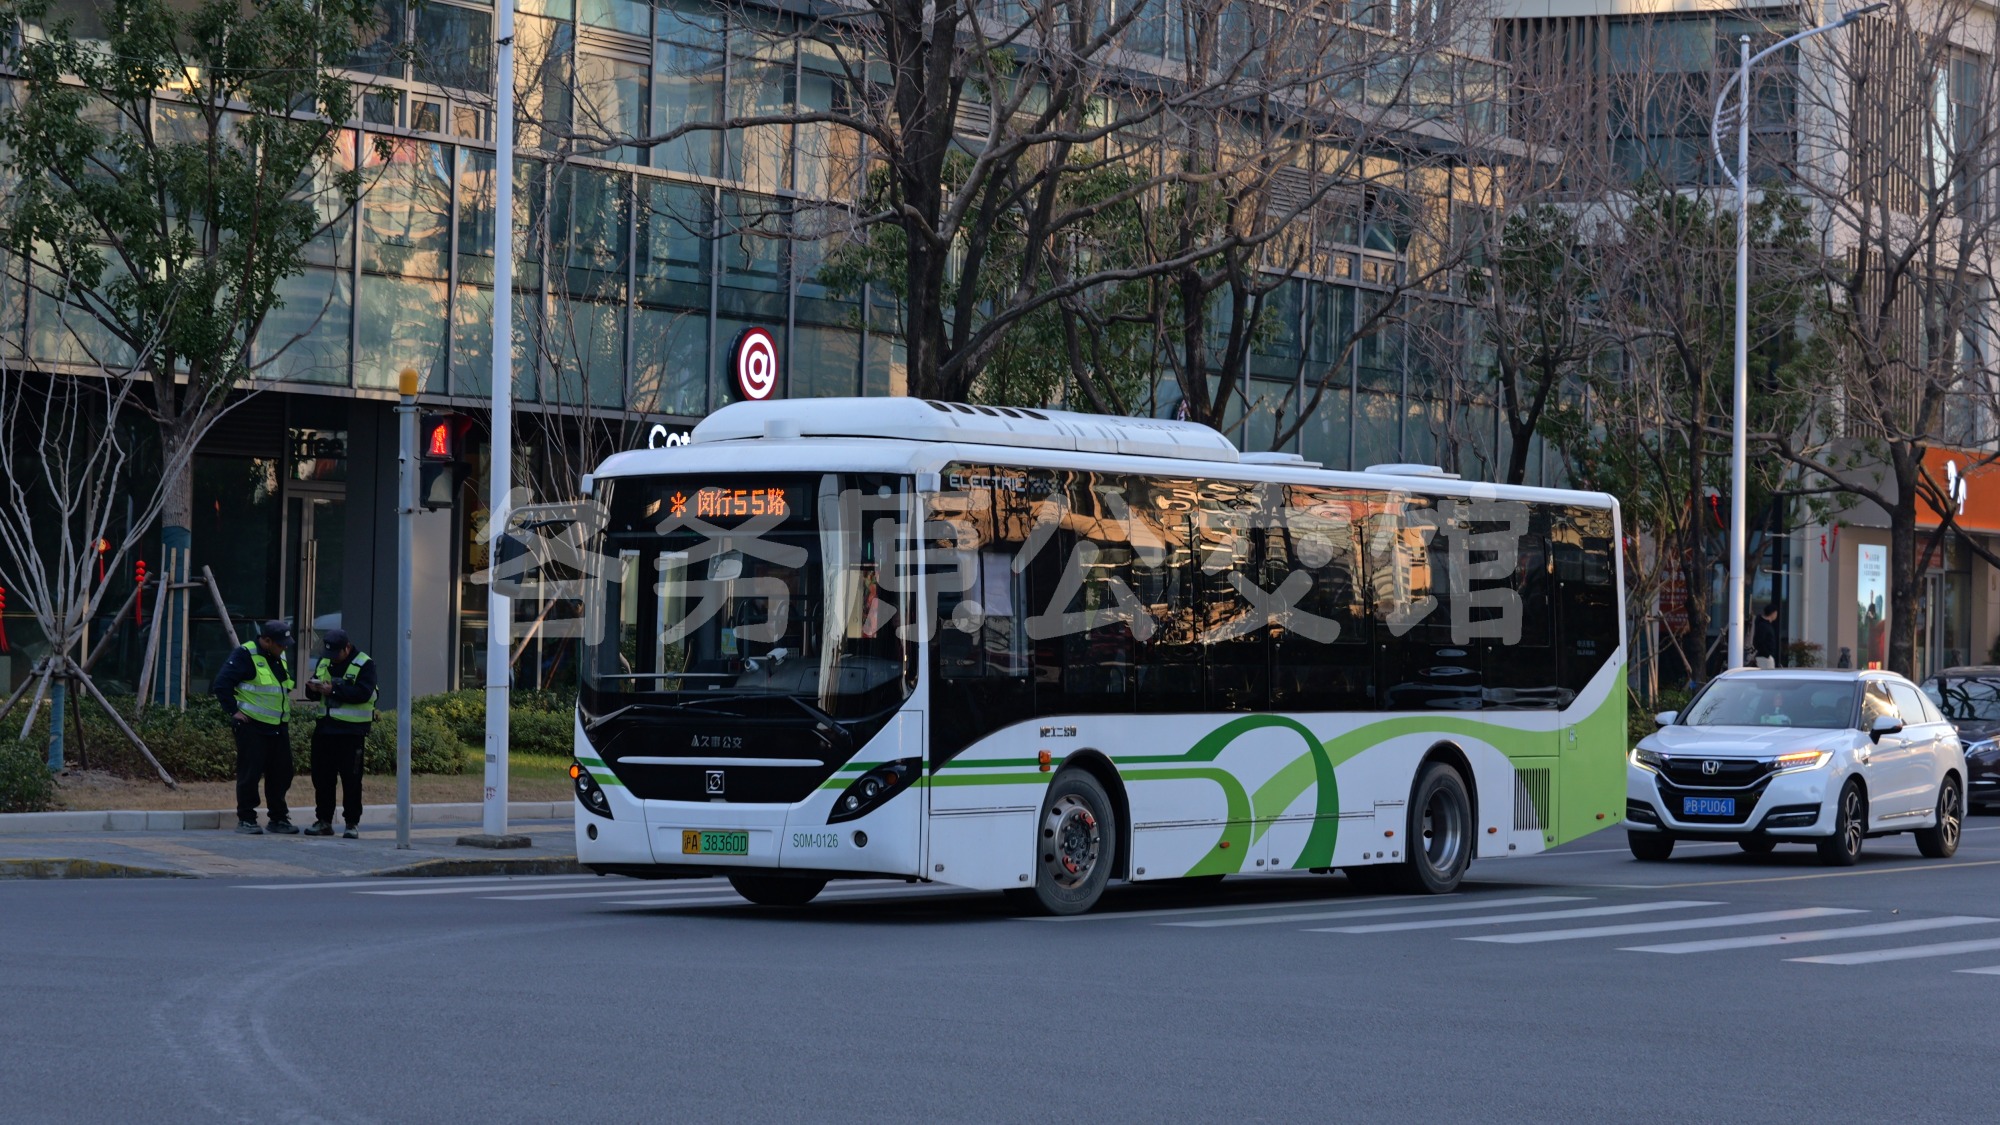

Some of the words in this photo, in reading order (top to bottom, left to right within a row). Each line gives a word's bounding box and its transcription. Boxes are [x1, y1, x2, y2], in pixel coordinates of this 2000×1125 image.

[949, 474, 1026, 492] ELECTRIC
[697, 488, 786, 517] 闵行55路
